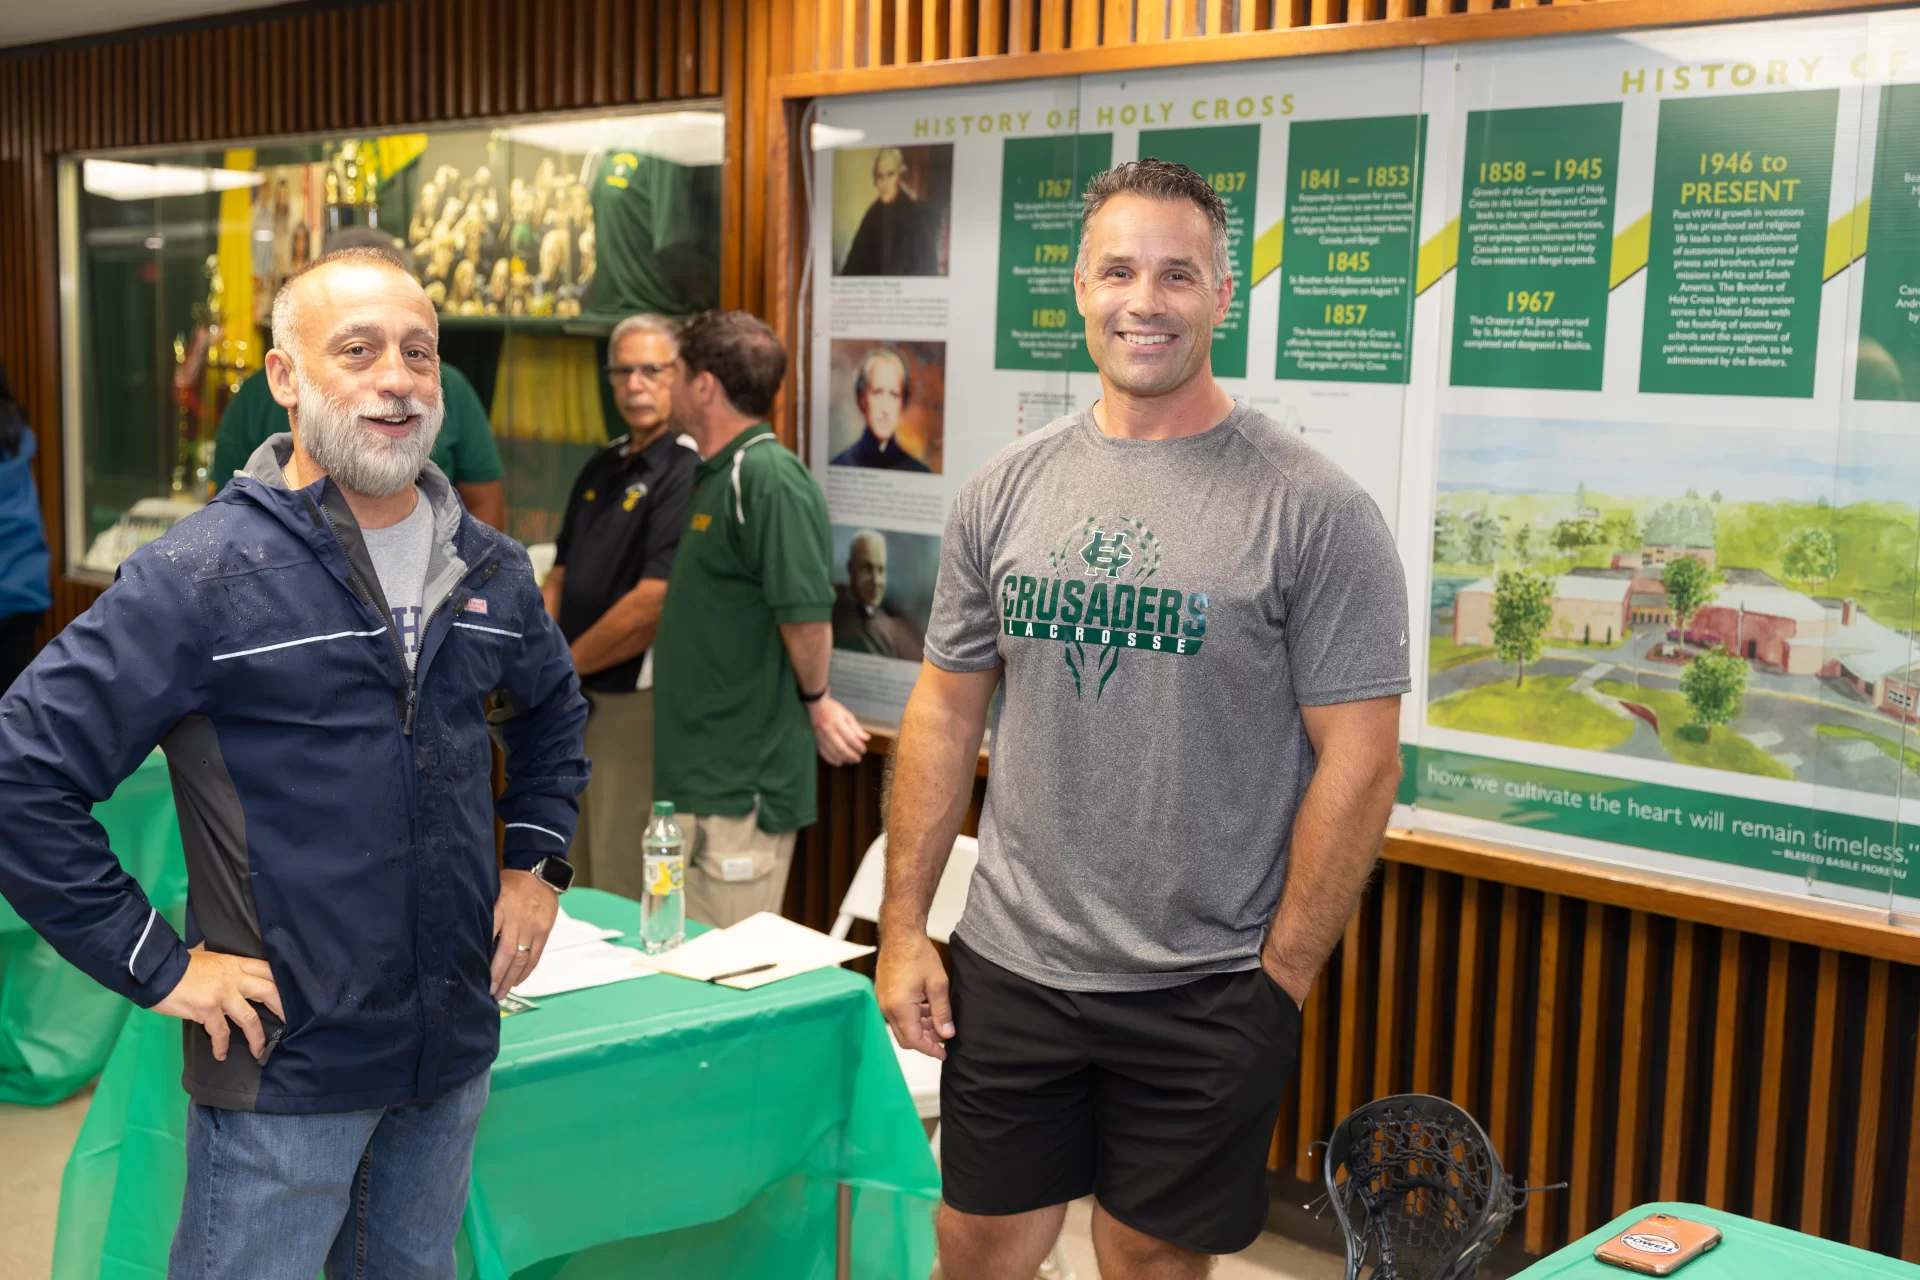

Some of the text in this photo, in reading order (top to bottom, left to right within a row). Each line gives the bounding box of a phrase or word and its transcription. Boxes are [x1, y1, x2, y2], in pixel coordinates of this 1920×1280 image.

[1621, 56, 1822, 94] HISTORY
[914, 95, 1294, 137] HISTORY OF HOLY CROSS
[1479, 161, 1526, 184] 1858
[1554, 158, 1602, 181] 1945
[1700, 152, 1787, 176] 1946 to
[1300, 168, 1340, 190] 1841
[1366, 166, 1410, 187] 1853
[1680, 180, 1800, 204] PRESENT
[1673, 209, 1691, 219] Post
[1691, 209, 1713, 218] WW
[1722, 209, 1752, 220] growth
[1701, 221, 1746, 232] priesthood
[1748, 221, 1763, 230] and
[1765, 221, 1800, 231] religious
[1676, 234, 1688, 243] life
[1690, 234, 1710, 243] leads
[1724, 234, 1738, 242] the
[1739, 233, 1797, 242] establishment
[1035, 244, 1069, 264] 1799
[1673, 244, 1799, 256] of autonomous jurisdictions of
[1328, 252, 1370, 272] 1845
[1674, 260, 1700, 270] priests
[1703, 258, 1718, 267] and
[1759, 258, 1775, 267] and
[1676, 271, 1710, 279] missions
[1721, 270, 1746, 279] Africa
[1748, 270, 1763, 279] and
[1765, 269, 1790, 279] South
[1719, 282, 1735, 292] The
[1737, 282, 1773, 292] Brothers
[1775, 282, 1786, 292] of
[1507, 290, 1556, 312] 1967
[1668, 295, 1688, 306] Holy
[1690, 294, 1714, 304] Cross
[1716, 295, 1738, 306] begin
[1752, 295, 1795, 306] expansion
[1324, 304, 1368, 325] 1857
[1698, 308, 1712, 316] the
[1714, 308, 1742, 316] United
[1744, 308, 1769, 316] States
[1771, 308, 1790, 316] with
[1676, 319, 1782, 331] the founding of secondary
[1668, 332, 1791, 343] schools and the assignment of
[1662, 344, 1687, 354] parish
[1689, 344, 1735, 355] elementary
[1736, 345, 1768, 354] schools
[1782, 345, 1793, 354] be
[1666, 356, 1718, 365] administered
[1720, 356, 1731, 367] by
[1732, 357, 1746, 366] the
[1003, 575, 1210, 638] CRUSADERS
[1009, 622, 1186, 654] LACROSSE
[1427, 764, 1466, 788] how
[1470, 774, 1499, 794] we
[1504, 779, 1583, 808] cultivate
[1589, 792, 1621, 815] the
[1628, 796, 1683, 825] heart
[1689, 810, 1724, 832] will
[1732, 819, 1805, 846] remain
[1784, 849, 1824, 865] BLESSED
[1826, 856, 1860, 872] BASILE
[1861, 863, 1907, 880] MOREAU
[1623, 1236, 1673, 1252] POWELL
